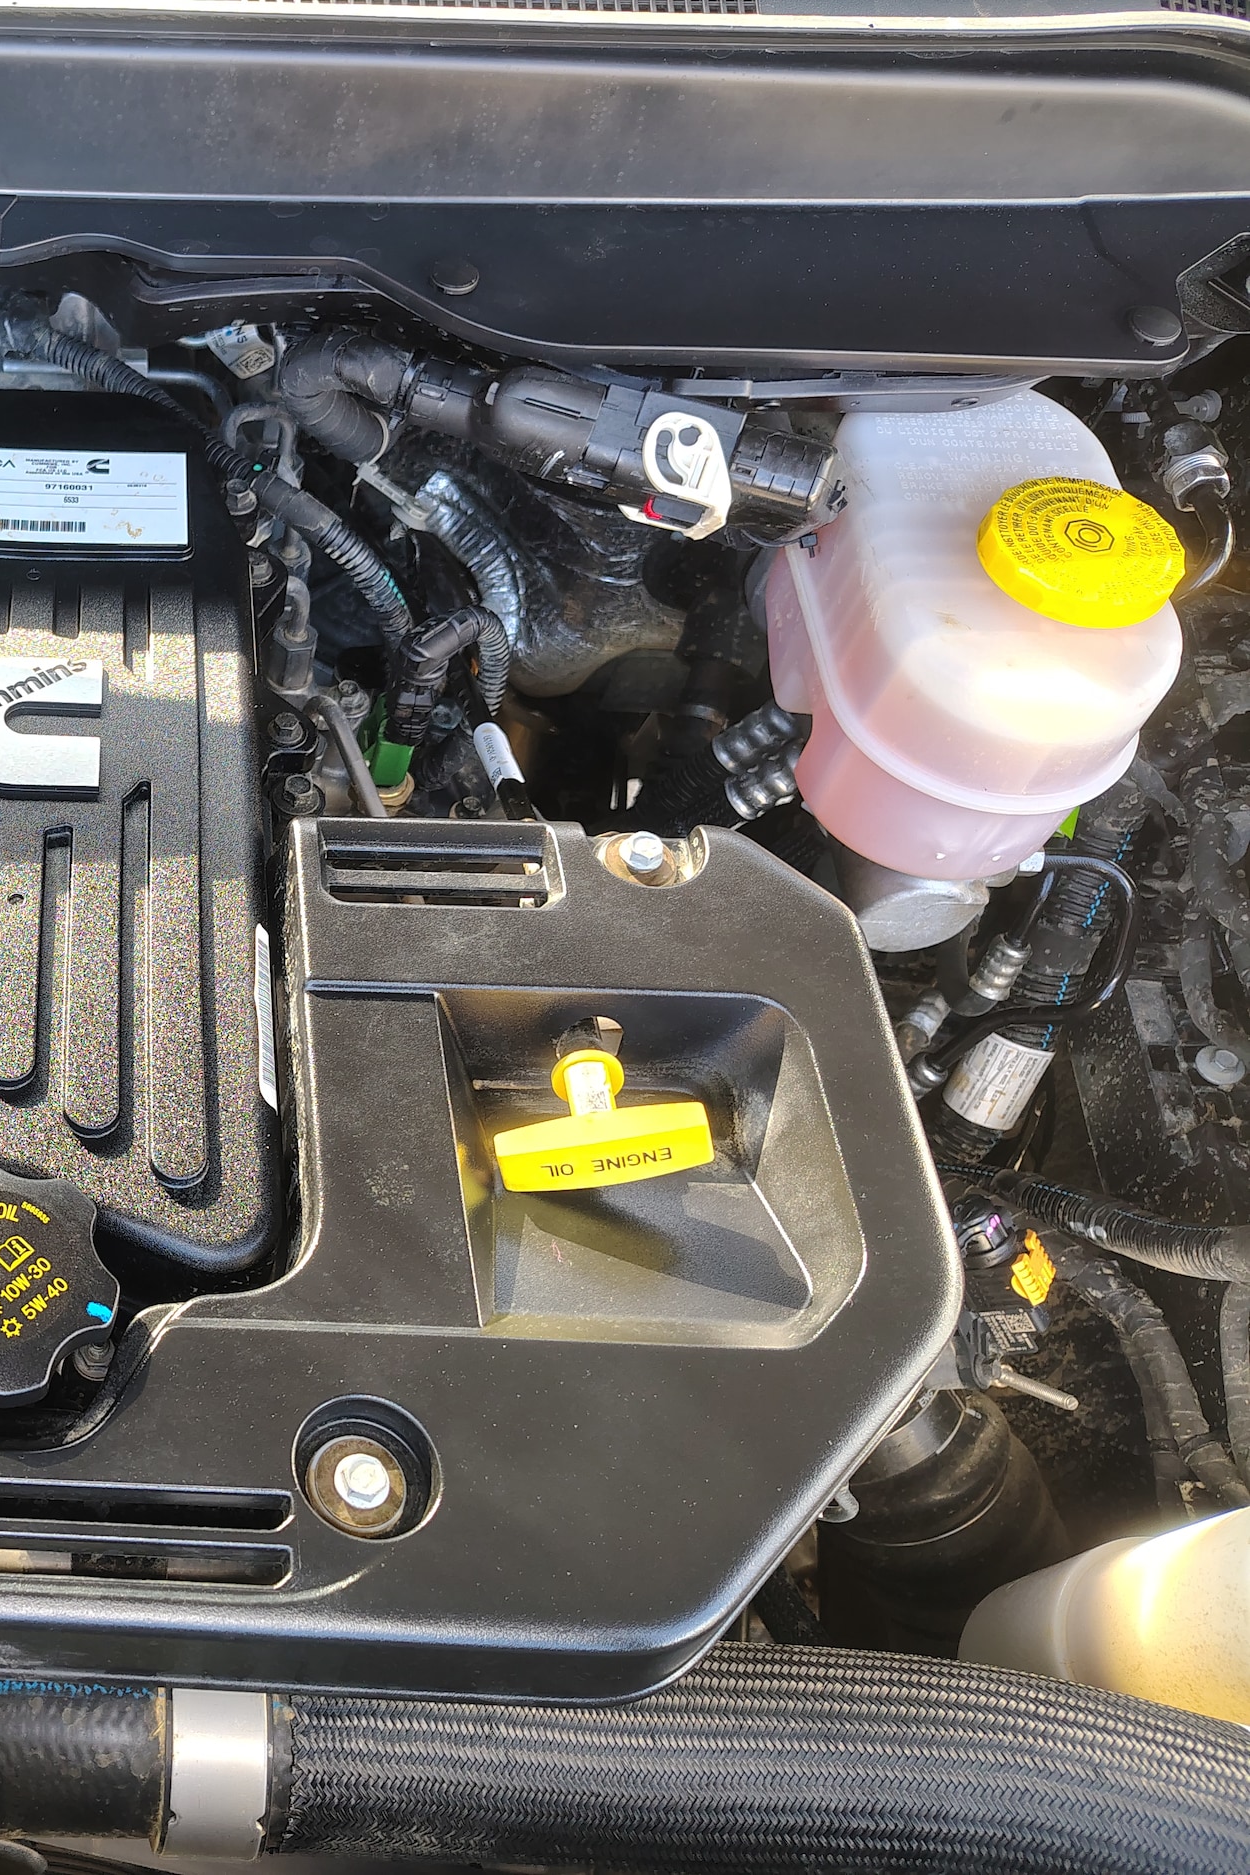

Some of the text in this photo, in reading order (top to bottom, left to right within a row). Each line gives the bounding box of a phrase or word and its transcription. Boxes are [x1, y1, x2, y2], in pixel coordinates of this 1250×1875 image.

[941, 438, 1018, 449] CONTENANT
[946, 451, 1031, 463] WARNING:
[45, 483, 93, 491] 97160031
[1006, 479, 1039, 504] BOUCHON
[1039, 477, 1053, 486] DE
[1054, 476, 1125, 499] REMPLISSAGE
[1046, 486, 1115, 501] UNIQUEMENT
[1031, 495, 1082, 516] PROVENANT
[1085, 497, 1110, 510] D'UN
[1027, 521, 1039, 536] DOT
[1042, 513, 1073, 559] CONTENANT
[540, 1147, 672, 1178] ENGINE OIL
[0, 1256, 52, 1303] 10W-30
[20, 1276, 69, 1320] 5W-40
